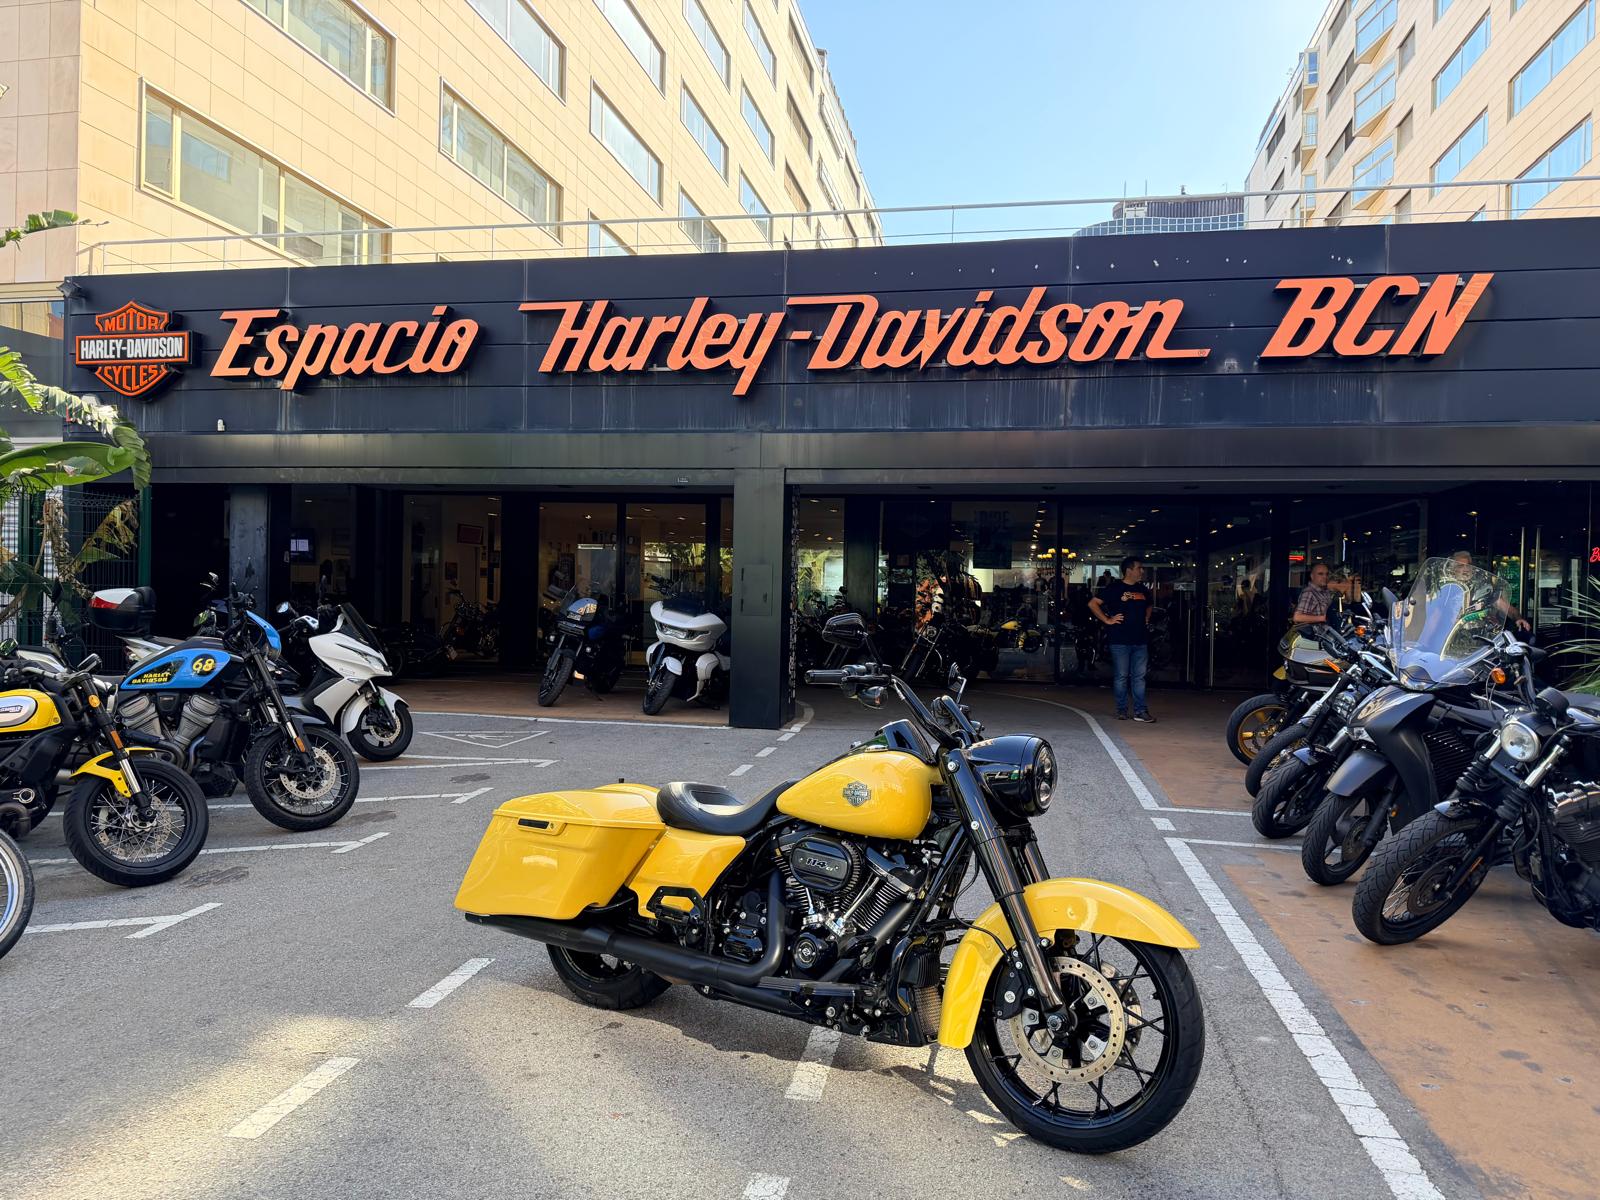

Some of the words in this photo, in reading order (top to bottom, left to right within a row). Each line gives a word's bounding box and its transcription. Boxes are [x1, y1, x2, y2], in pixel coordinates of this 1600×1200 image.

[104, 308, 159, 331] MOTOR
[210, 304, 480, 391] Espacio
[518, 285, 1211, 397] Harley-Davidson
[1259, 271, 1495, 358] BCN
[80, 337, 183, 359] HARLEY-DAVIDSON
[103, 365, 159, 391] CYCLES
[192, 658, 216, 674] 68
